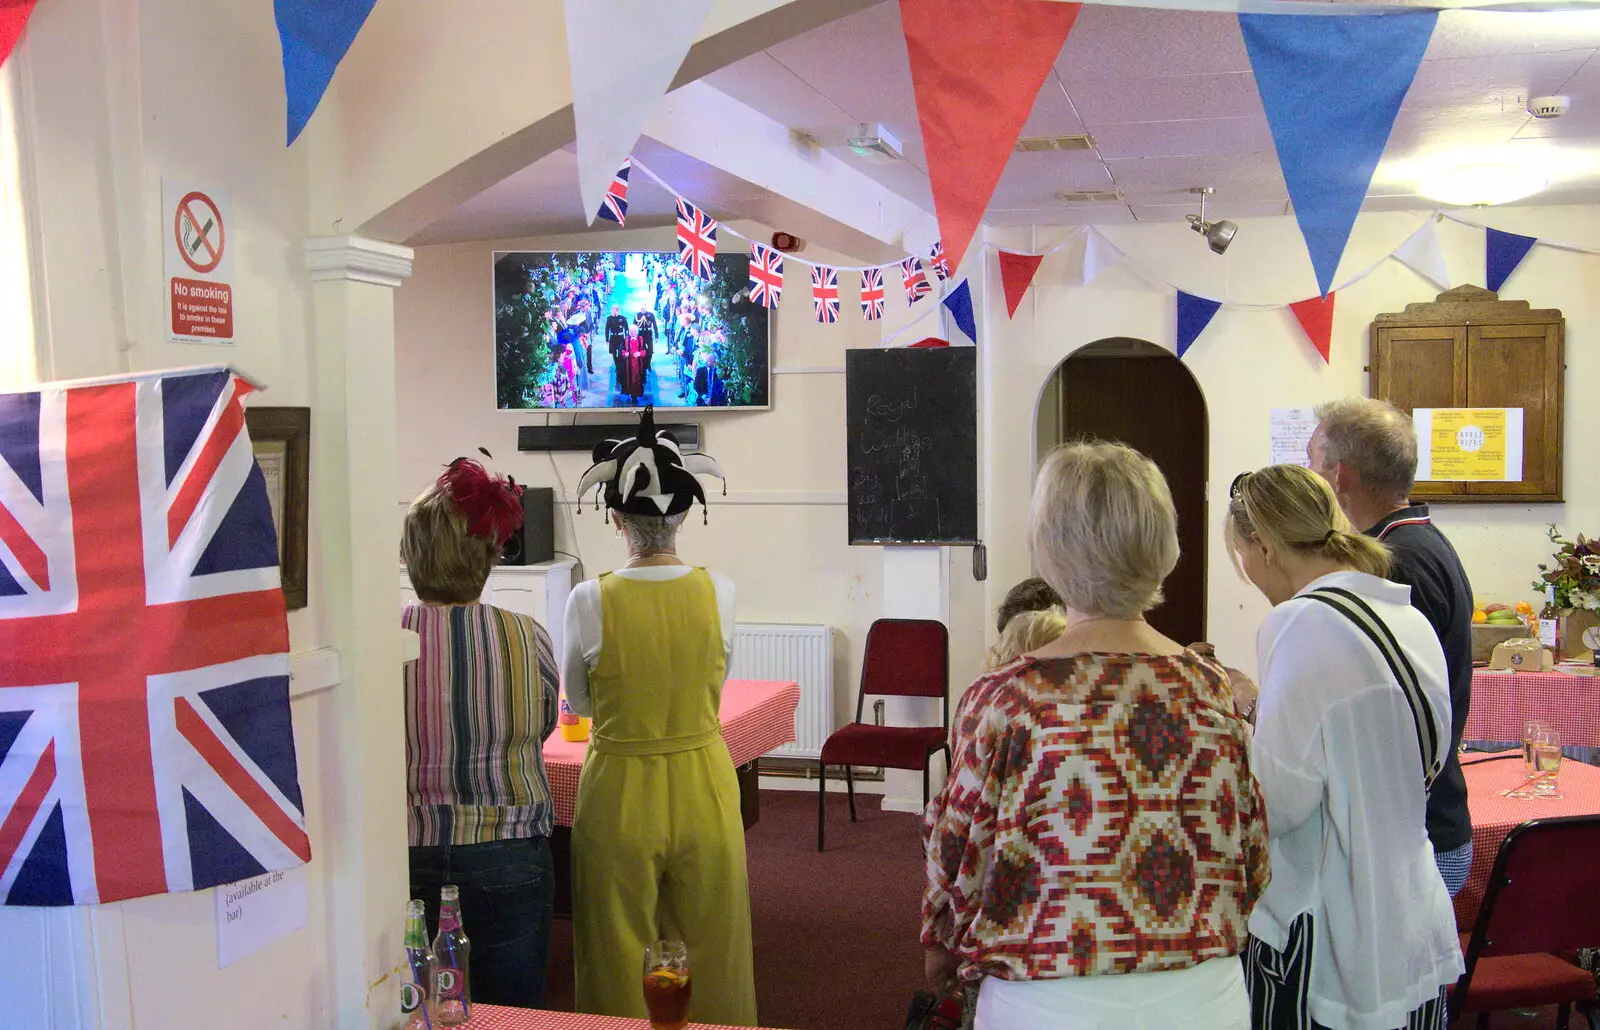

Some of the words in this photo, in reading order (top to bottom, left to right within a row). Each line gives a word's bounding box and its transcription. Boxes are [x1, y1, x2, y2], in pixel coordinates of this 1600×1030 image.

[174, 282, 188, 296] No
[190, 287, 229, 304] smoking
[177, 302, 182, 310] It
[183, 303, 188, 311] is
[189, 304, 208, 313] against
[209, 305, 217, 314] the
[180, 313, 186, 321] to
[186, 315, 204, 323] smoke
[211, 316, 226, 325] these
[191, 325, 216, 334] premises
[1456, 439, 1483, 447] PRIZES
[226, 880, 263, 908] (available
[264, 874, 272, 887] at
[272, 870, 285, 883] the
[226, 906, 243, 923] bar)
